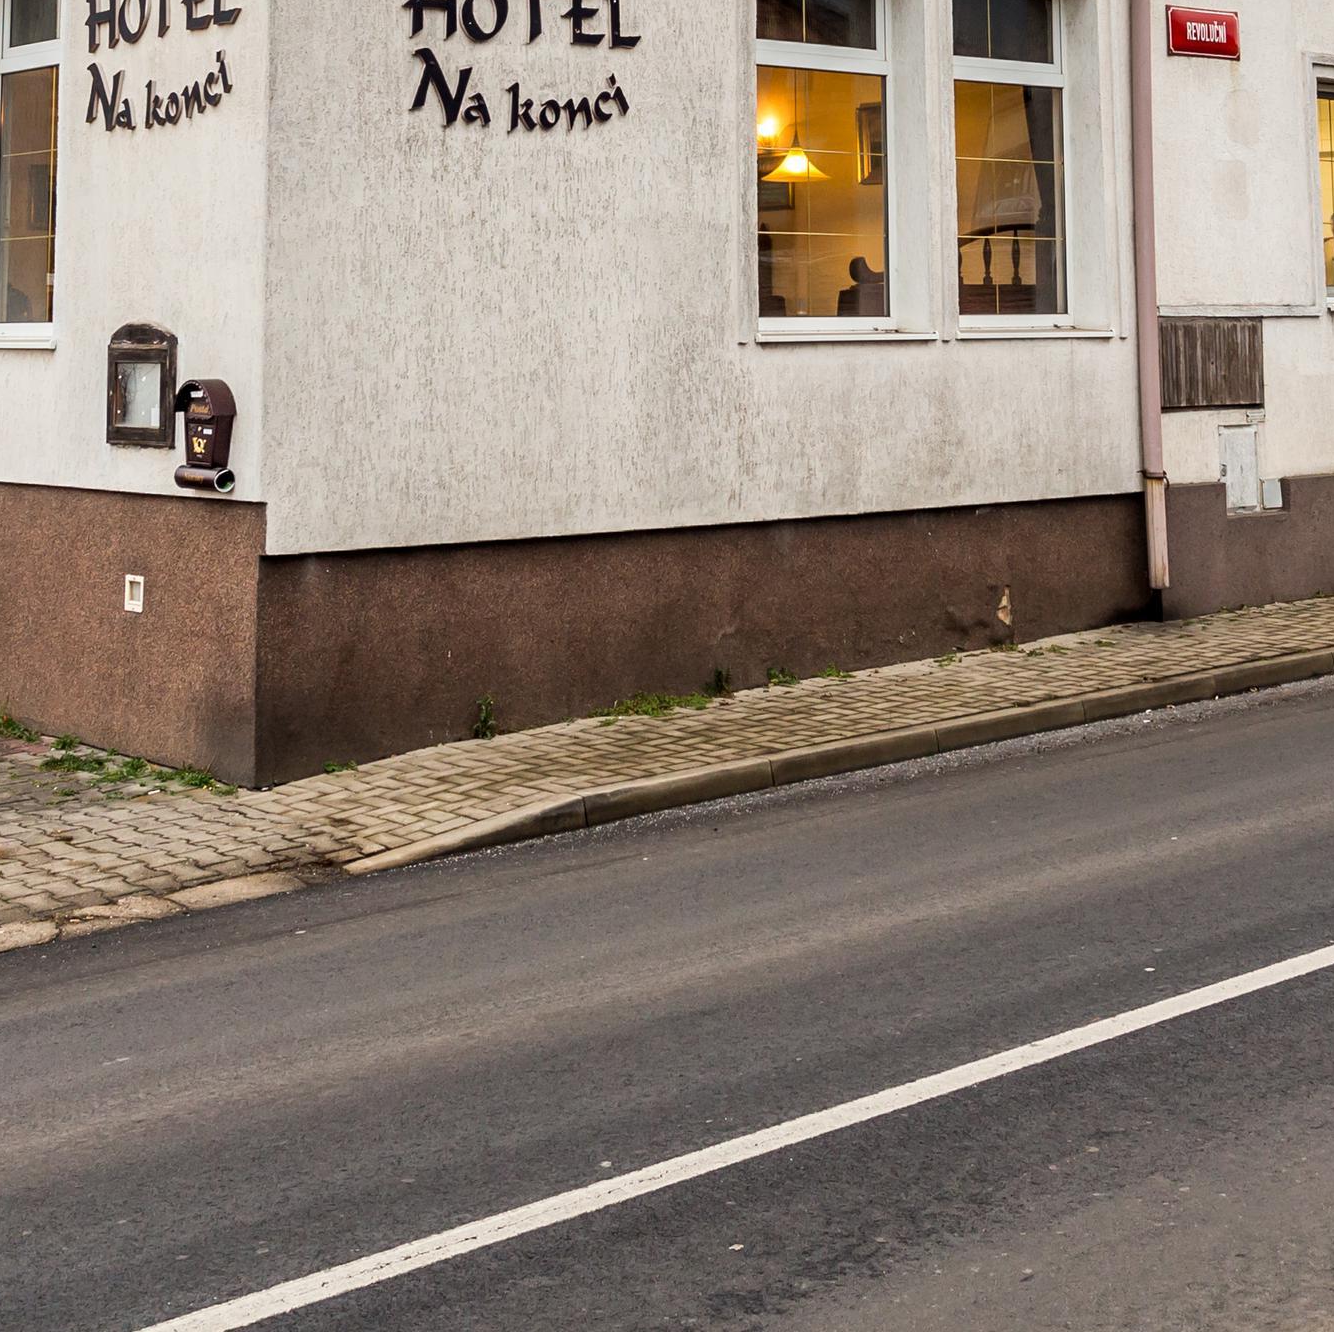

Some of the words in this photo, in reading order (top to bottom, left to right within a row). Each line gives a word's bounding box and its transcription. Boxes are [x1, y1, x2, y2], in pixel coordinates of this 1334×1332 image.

[1186, 21, 1227, 44] REVOLUČNÍ
[86, 62, 136, 131] Na
[145, 49, 233, 129] konci
[409, 47, 491, 128] Na
[505, 73, 630, 134] konci
